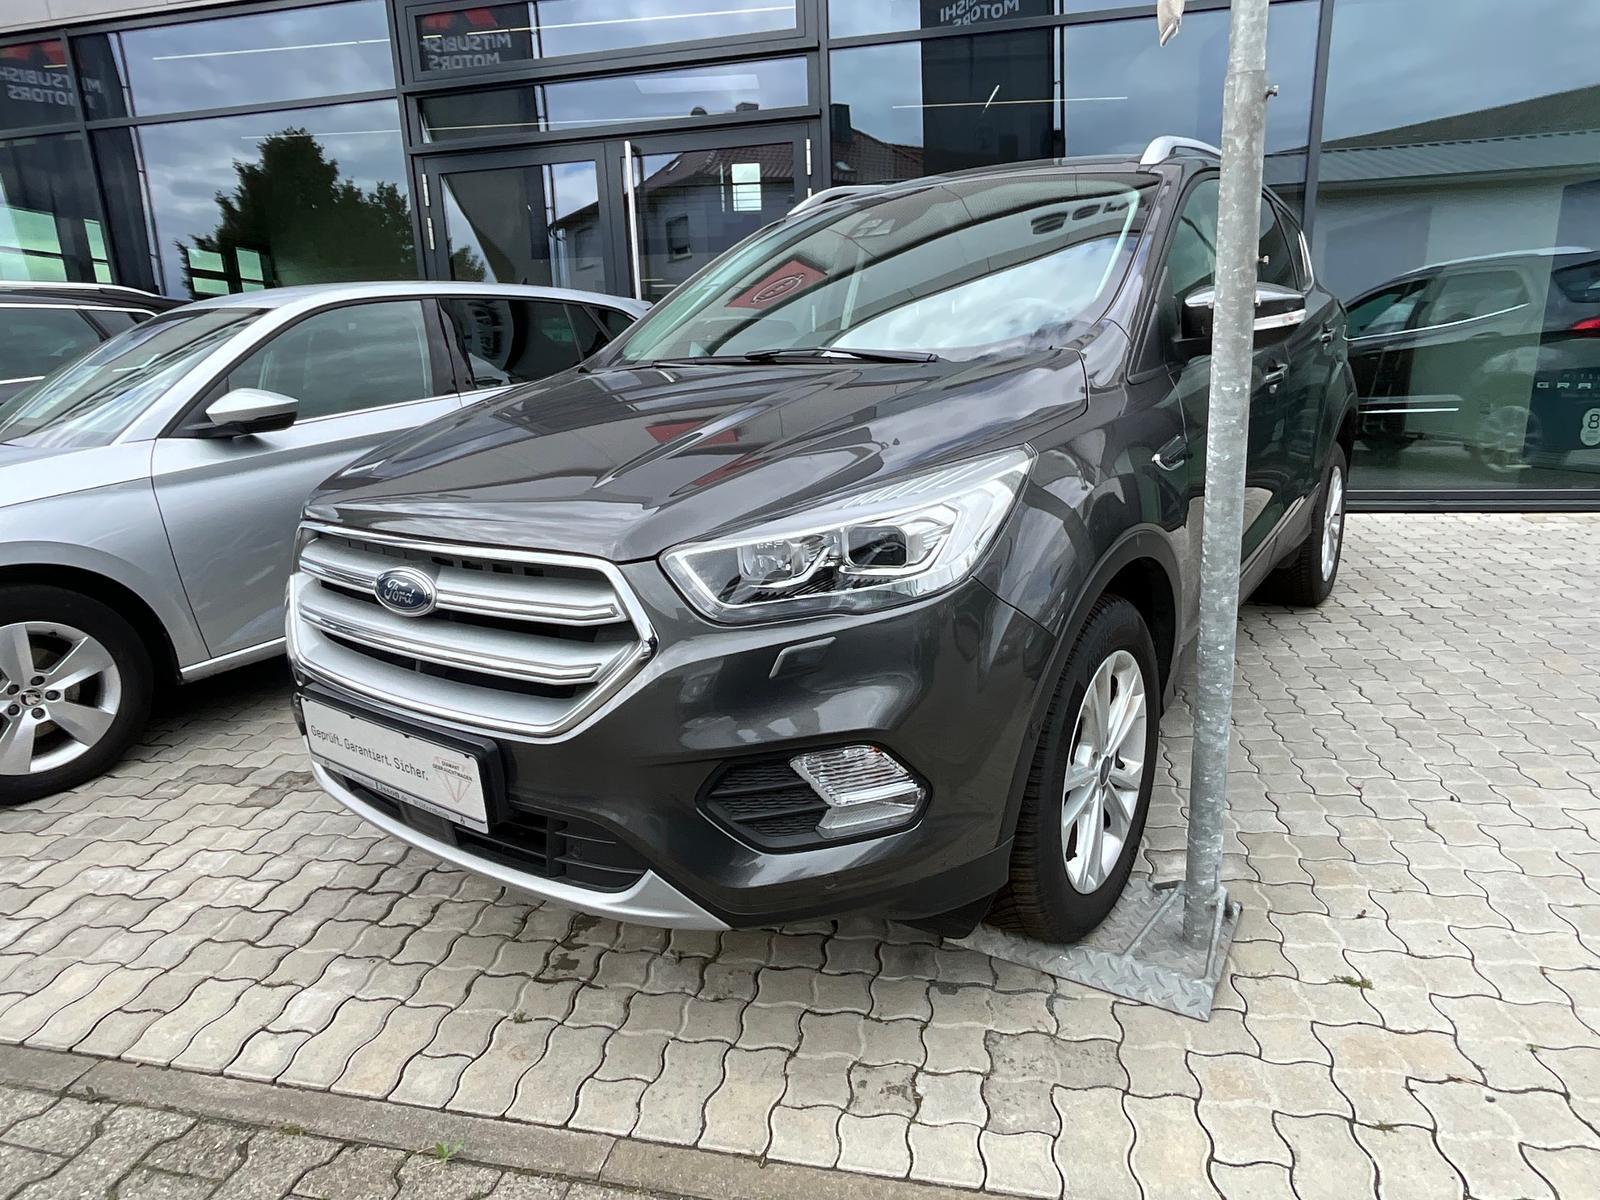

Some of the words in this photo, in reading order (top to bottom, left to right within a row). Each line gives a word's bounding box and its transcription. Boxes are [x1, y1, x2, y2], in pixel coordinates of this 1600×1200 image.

[384, 578, 416, 605] Ford
[310, 724, 343, 747] Geprüft.
[344, 738, 392, 767] Garantiert.
[393, 757, 429, 781] Sicher.
